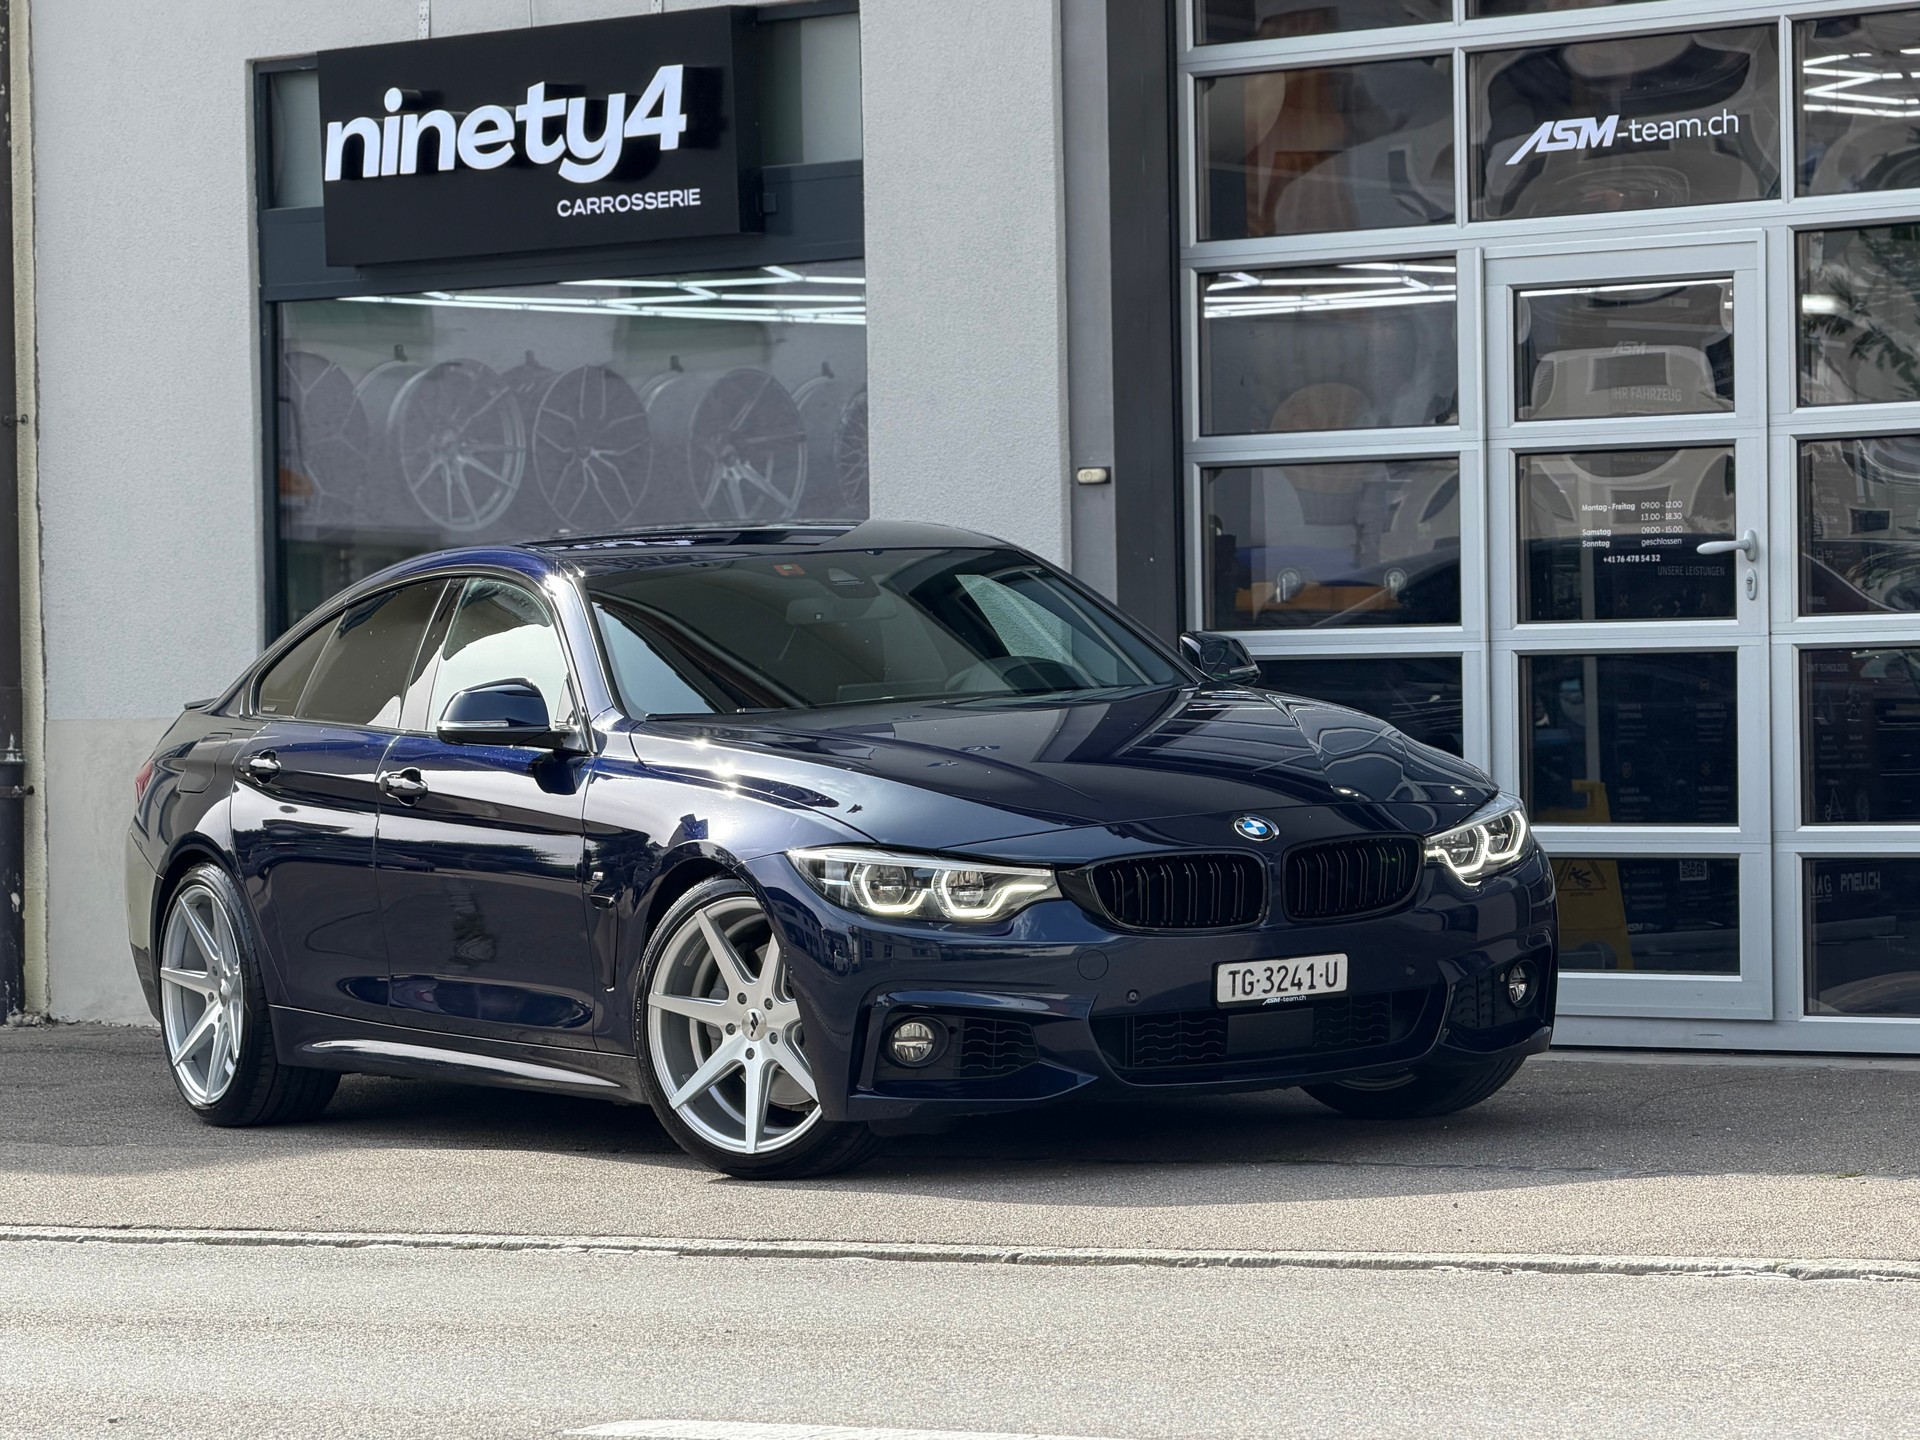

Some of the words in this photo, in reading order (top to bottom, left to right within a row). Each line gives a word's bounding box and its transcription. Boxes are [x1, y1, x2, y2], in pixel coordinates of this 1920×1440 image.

[324, 63, 687, 184] ninety4
[1505, 108, 1739, 165] ASM-team.ch
[557, 188, 701, 217] CARROSSERIE
[1630, 387, 1682, 402] FAHRZEUG
[1641, 501, 1660, 509] 09.00
[1665, 500, 1682, 508] 12.00
[1641, 513, 1660, 521] 13.00
[1582, 528, 1611, 537] Samstag
[1641, 526, 1660, 534] 09.00
[1665, 525, 1683, 533] 15.00
[1582, 540, 1610, 549] Sonntag
[1641, 536, 1682, 547] geschlossen
[1657, 565, 1684, 576] UNSERE
[1685, 565, 1725, 577] LEISTUNGEN
